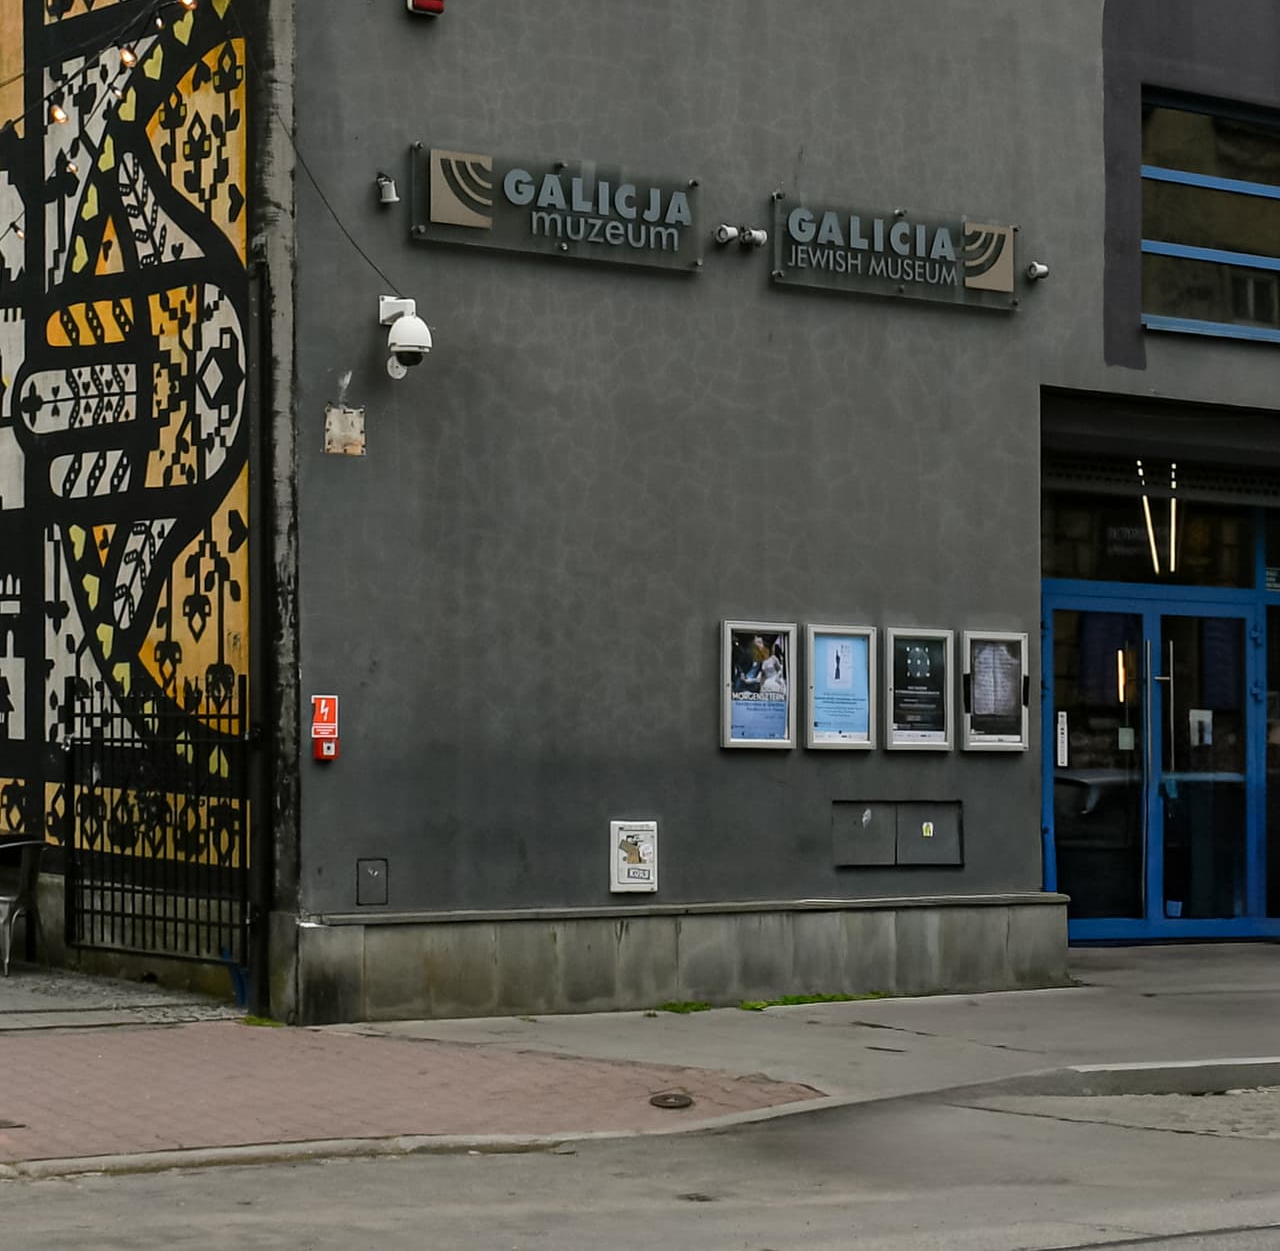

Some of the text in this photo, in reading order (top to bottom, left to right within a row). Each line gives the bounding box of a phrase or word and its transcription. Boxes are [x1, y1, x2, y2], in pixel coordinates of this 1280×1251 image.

[503, 169, 692, 226] GALICJA
[531, 210, 679, 251] muzeum
[788, 207, 957, 261] GALICIA
[787, 245, 959, 286] JEWISH MUSEUM
